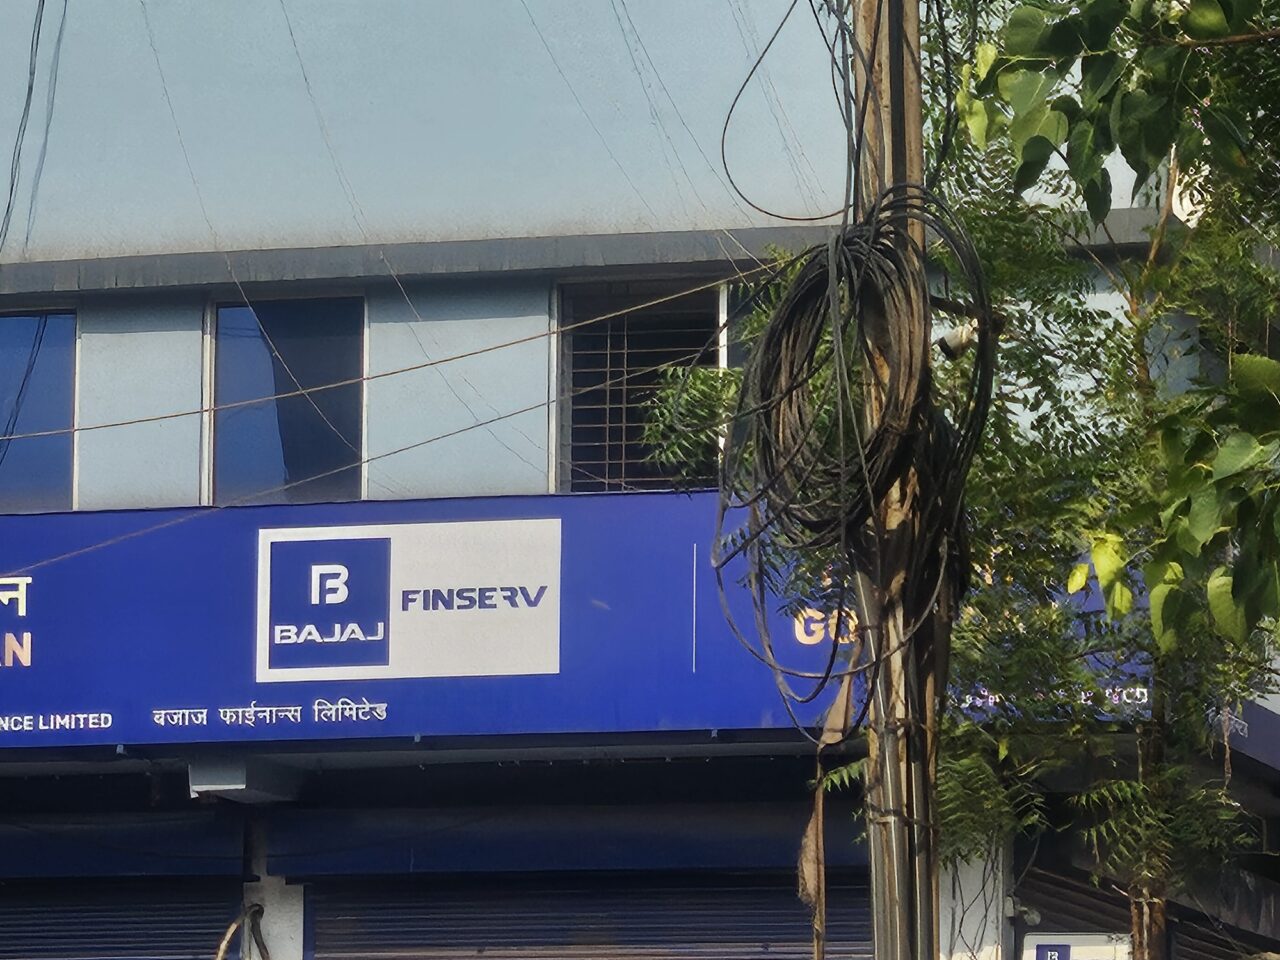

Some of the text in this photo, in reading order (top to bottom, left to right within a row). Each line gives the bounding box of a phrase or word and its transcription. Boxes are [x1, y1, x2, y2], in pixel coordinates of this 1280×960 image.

[401, 585, 548, 612] FINSERV
[274, 622, 384, 645] BAJAJ
[39, 713, 112, 731] LIMITED
[153, 708, 207, 727] बजाज
[313, 696, 388, 722] लिमिटेड
